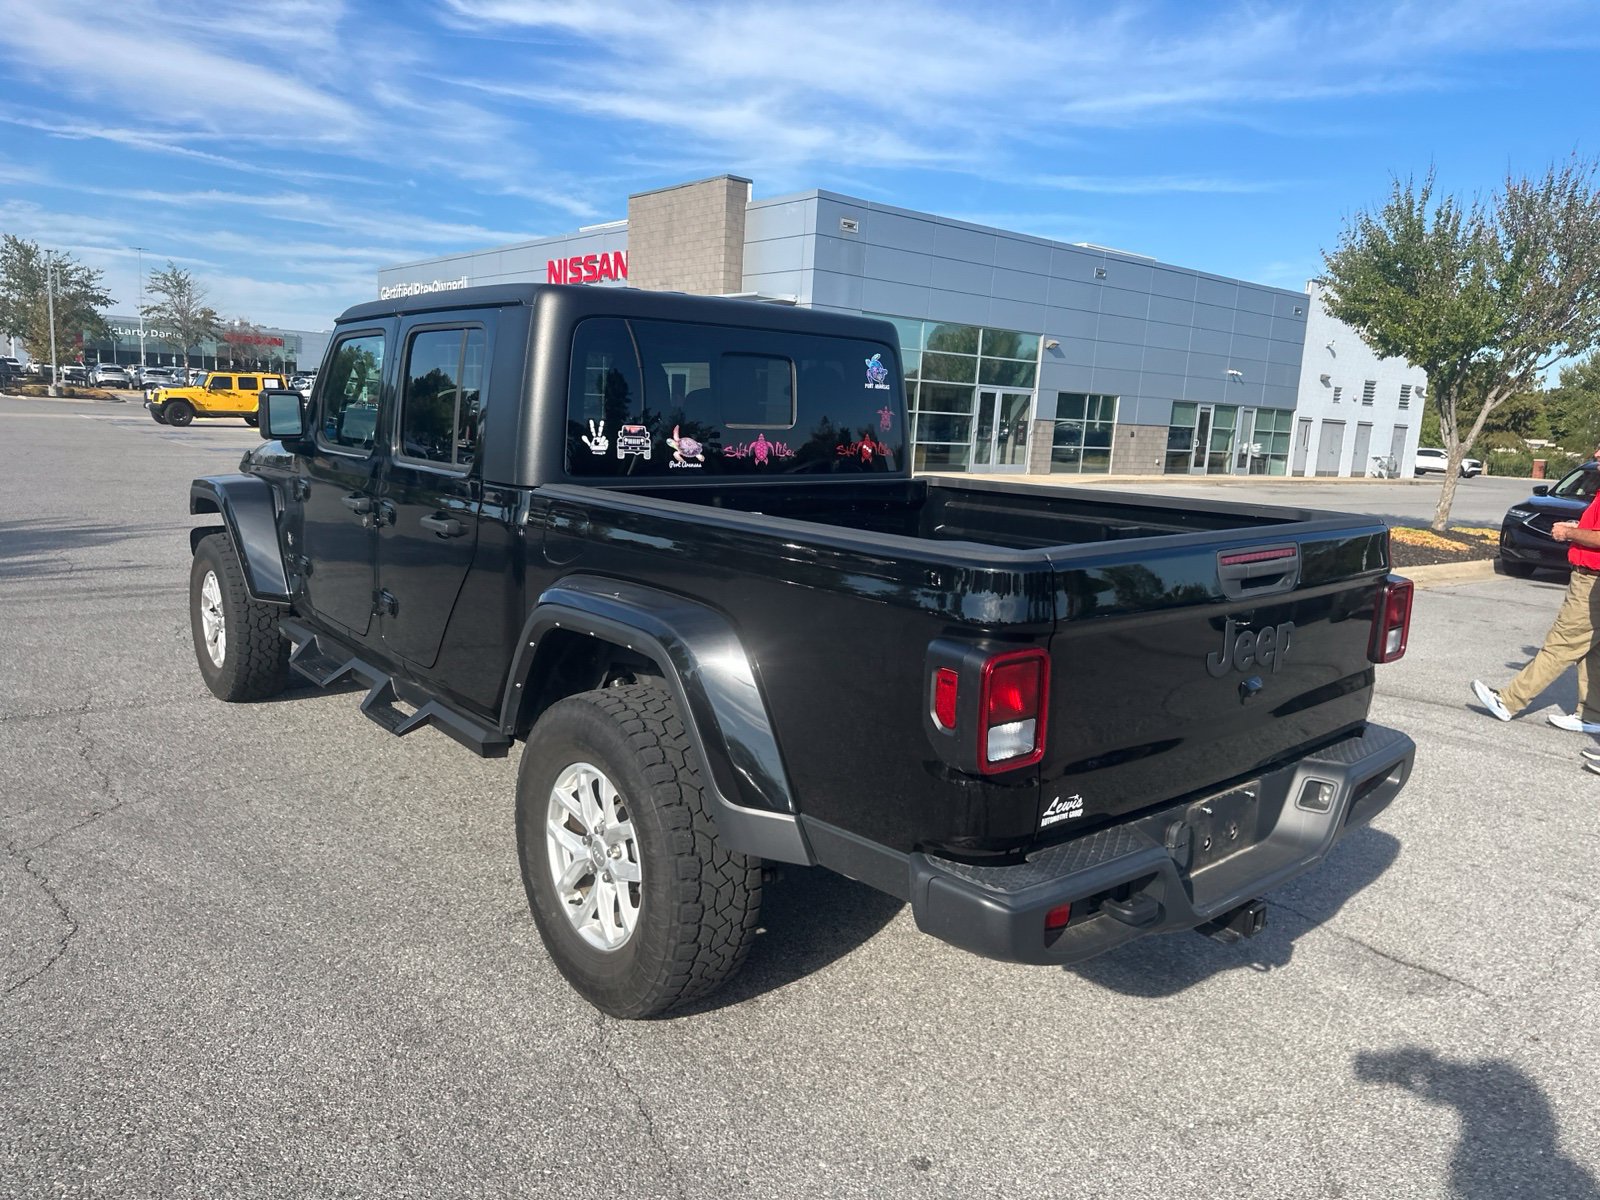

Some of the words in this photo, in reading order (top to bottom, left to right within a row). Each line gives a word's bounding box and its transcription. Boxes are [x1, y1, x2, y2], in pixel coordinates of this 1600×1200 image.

[547, 250, 629, 285] NISSAN
[381, 282, 413, 300] Certified
[1206, 619, 1296, 678] Jeep
[1043, 796, 1083, 817] Lewis
[1041, 812, 1068, 827] AUTOMOTIVE
[1068, 808, 1083, 818] GROUP
